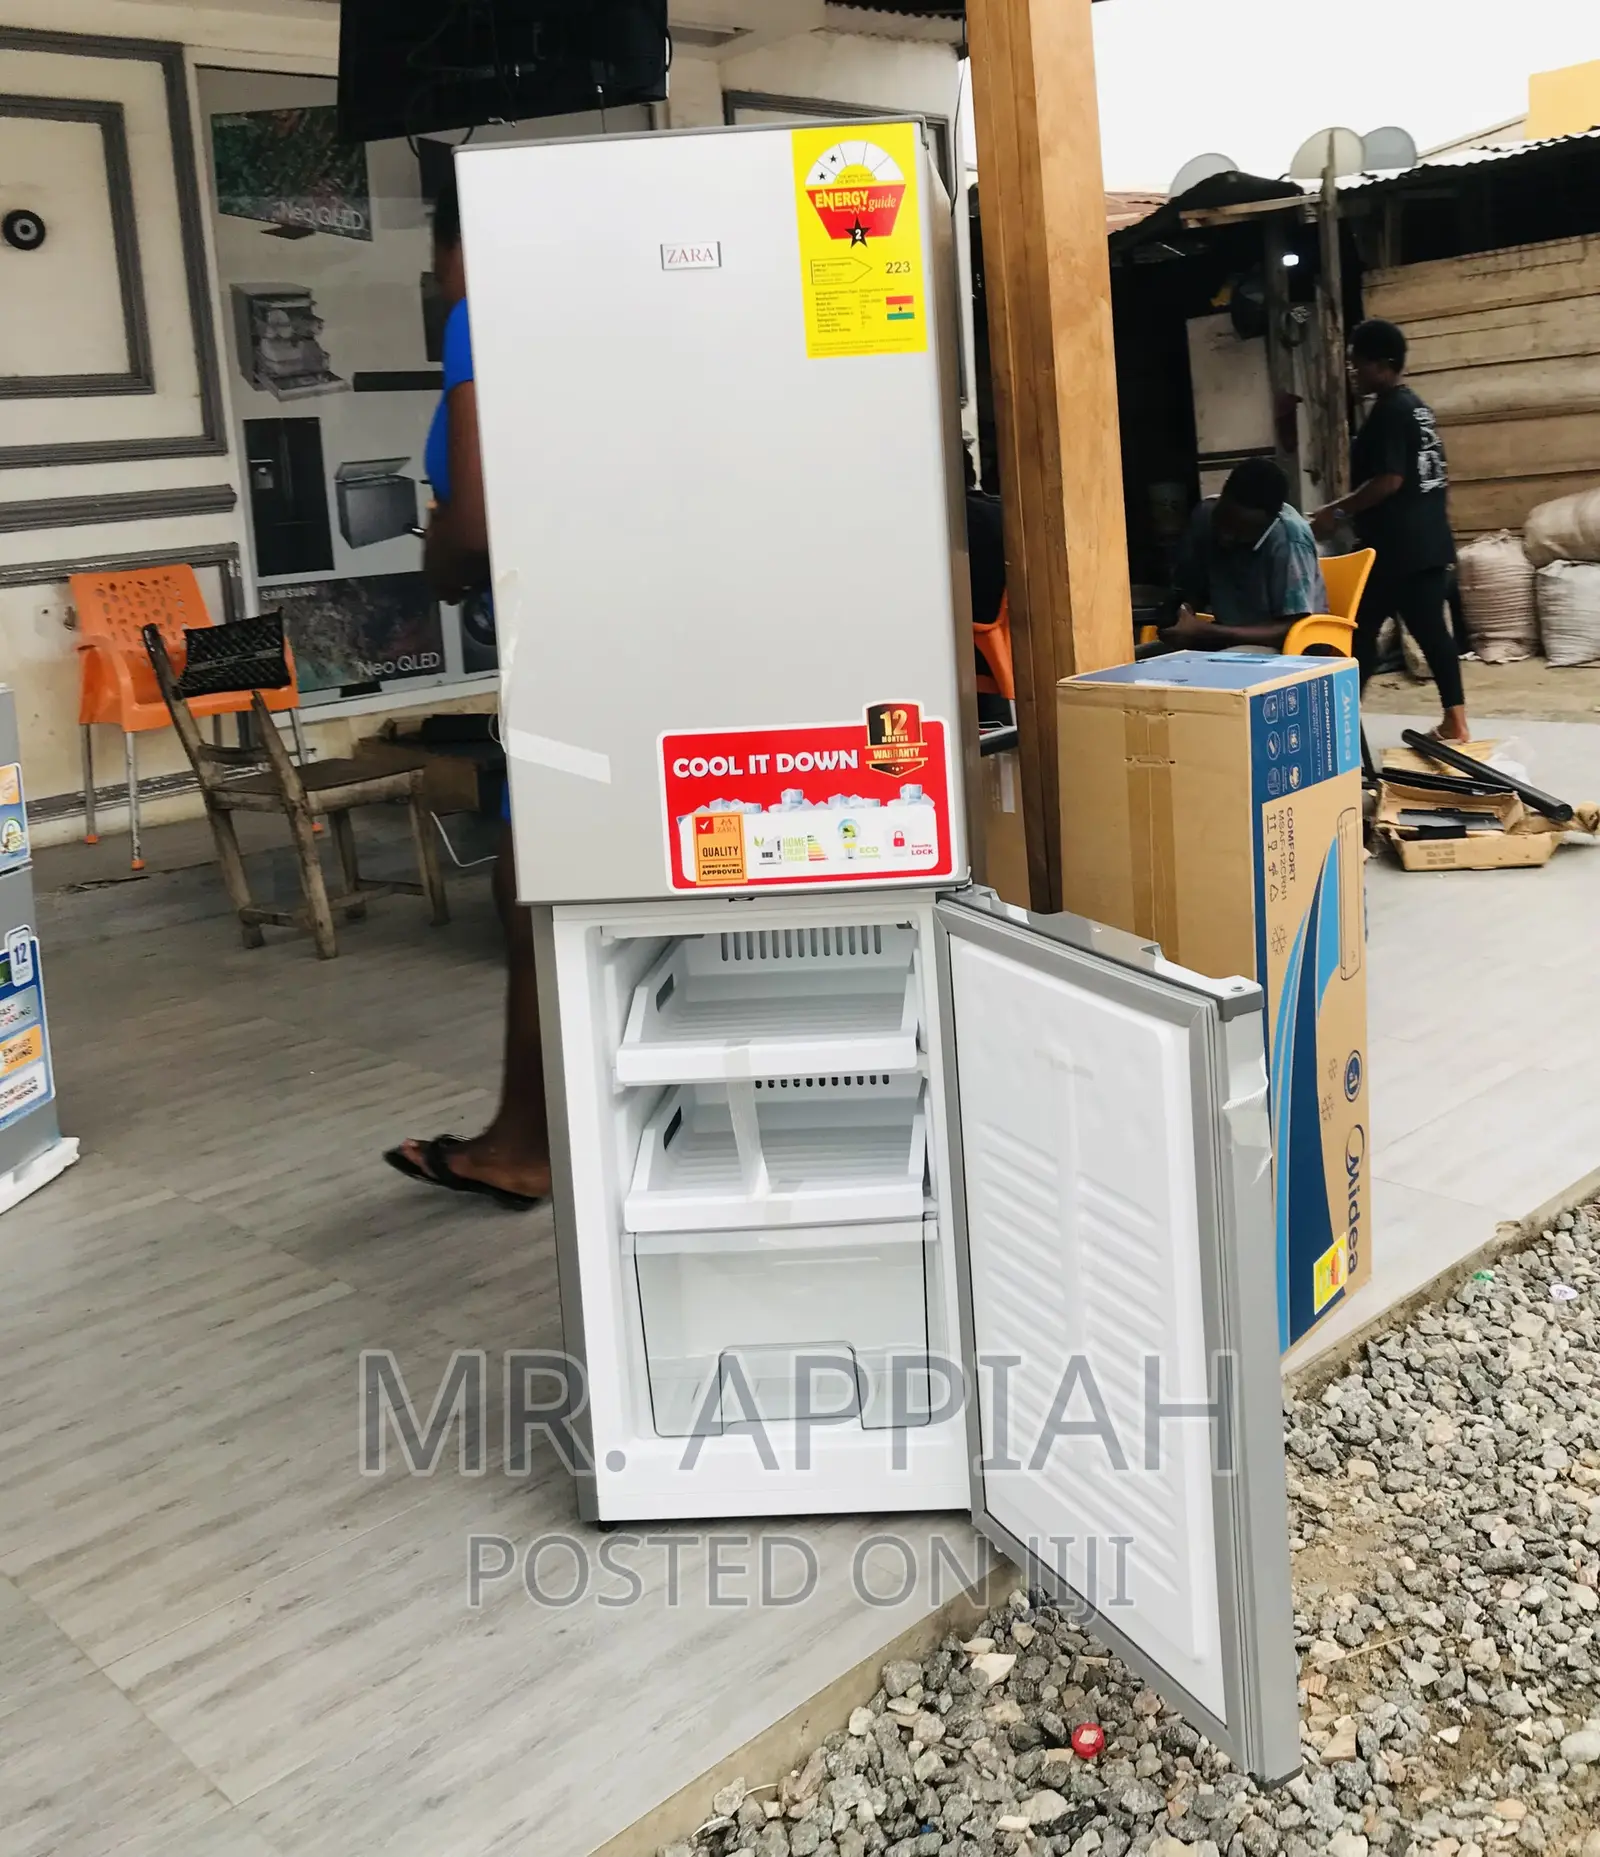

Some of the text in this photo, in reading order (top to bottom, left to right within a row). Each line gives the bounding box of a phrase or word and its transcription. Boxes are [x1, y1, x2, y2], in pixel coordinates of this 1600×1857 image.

[815, 190, 897, 212] ENERGY guide
[855, 229, 862, 240] 2
[667, 248, 714, 264] ZARA
[885, 261, 911, 274] 223
[357, 652, 440, 677] Neo QLED
[880, 709, 907, 737] 12
[1323, 679, 1332, 772] AIR-CONDITIONER
[1341, 679, 1354, 761] Midea
[881, 735, 908, 744] MONTHS
[673, 749, 858, 778] COOL IT DOWN
[873, 747, 919, 760] WARRANTY
[702, 846, 739, 857] QUALITY
[860, 846, 879, 854] ECO
[1287, 806, 1296, 882] COMFORT
[702, 868, 743, 876] APPROVED
[14, 942, 28, 965] 12
[1345, 1124, 1364, 1276] Midea
